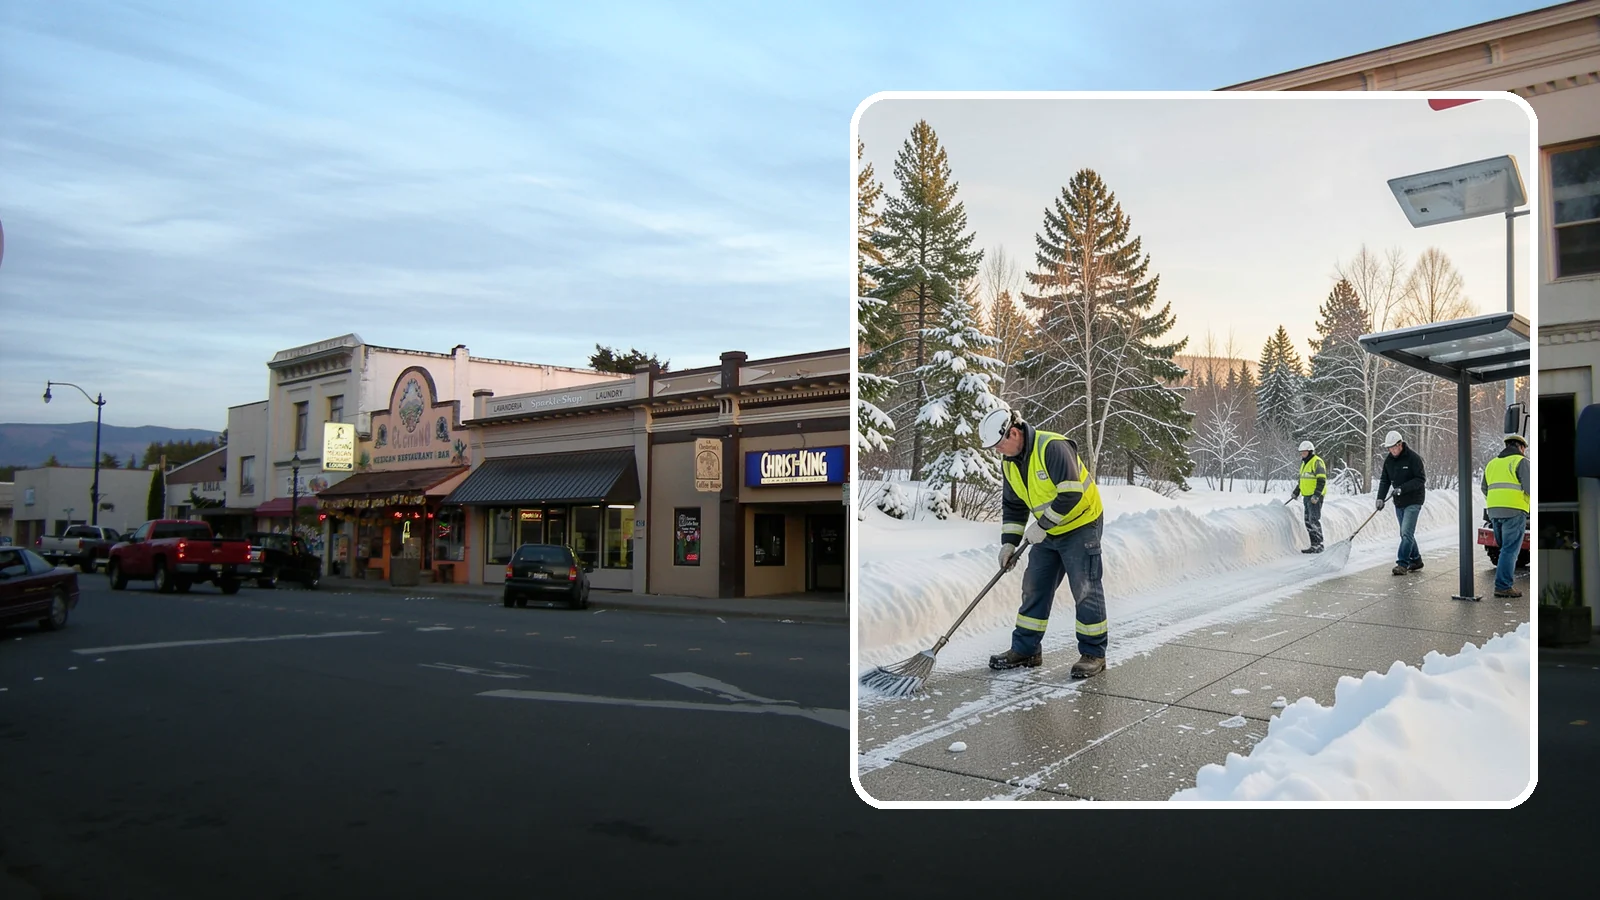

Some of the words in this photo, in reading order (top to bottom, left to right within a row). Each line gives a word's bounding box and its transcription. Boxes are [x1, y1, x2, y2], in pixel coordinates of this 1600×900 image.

[493, 402, 522, 413] LAVANDERIA
[530, 397, 561, 409] Sparkle
[561, 394, 583, 405] Shop
[595, 388, 623, 400] LAUNDRY
[373, 455, 396, 464] MEXICAN
[397, 451, 433, 462] RESTAURANT
[437, 450, 450, 459] BAR
[761, 452, 797, 478] CHRIST
[799, 450, 827, 476] KING
